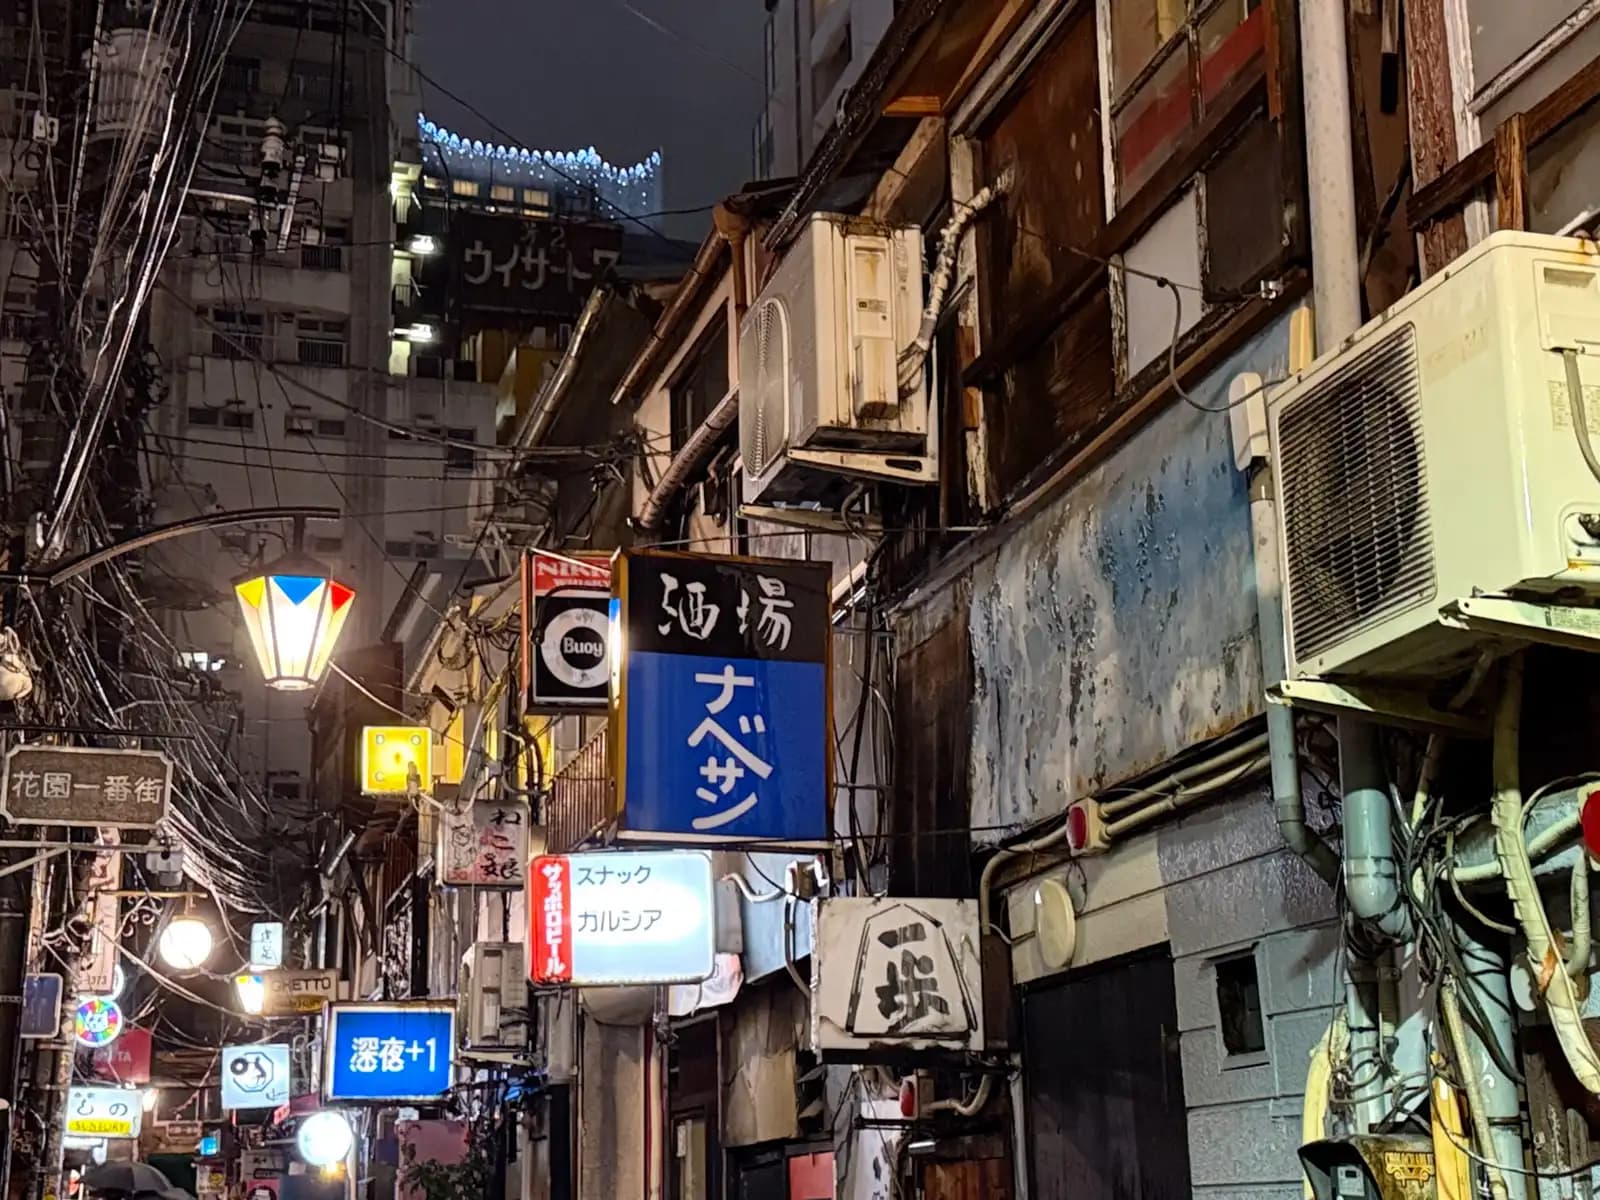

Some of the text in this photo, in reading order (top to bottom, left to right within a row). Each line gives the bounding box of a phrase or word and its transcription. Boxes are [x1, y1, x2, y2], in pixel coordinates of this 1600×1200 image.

[658, 572, 794, 651] 酒場
[563, 636, 603, 657] Buoy
[687, 664, 774, 830] ナベサン
[11, 770, 164, 804] 花園一番街
[577, 866, 651, 886] スナック
[541, 863, 566, 977] サッポロビール
[349, 1036, 436, 1073] 深夜+1
